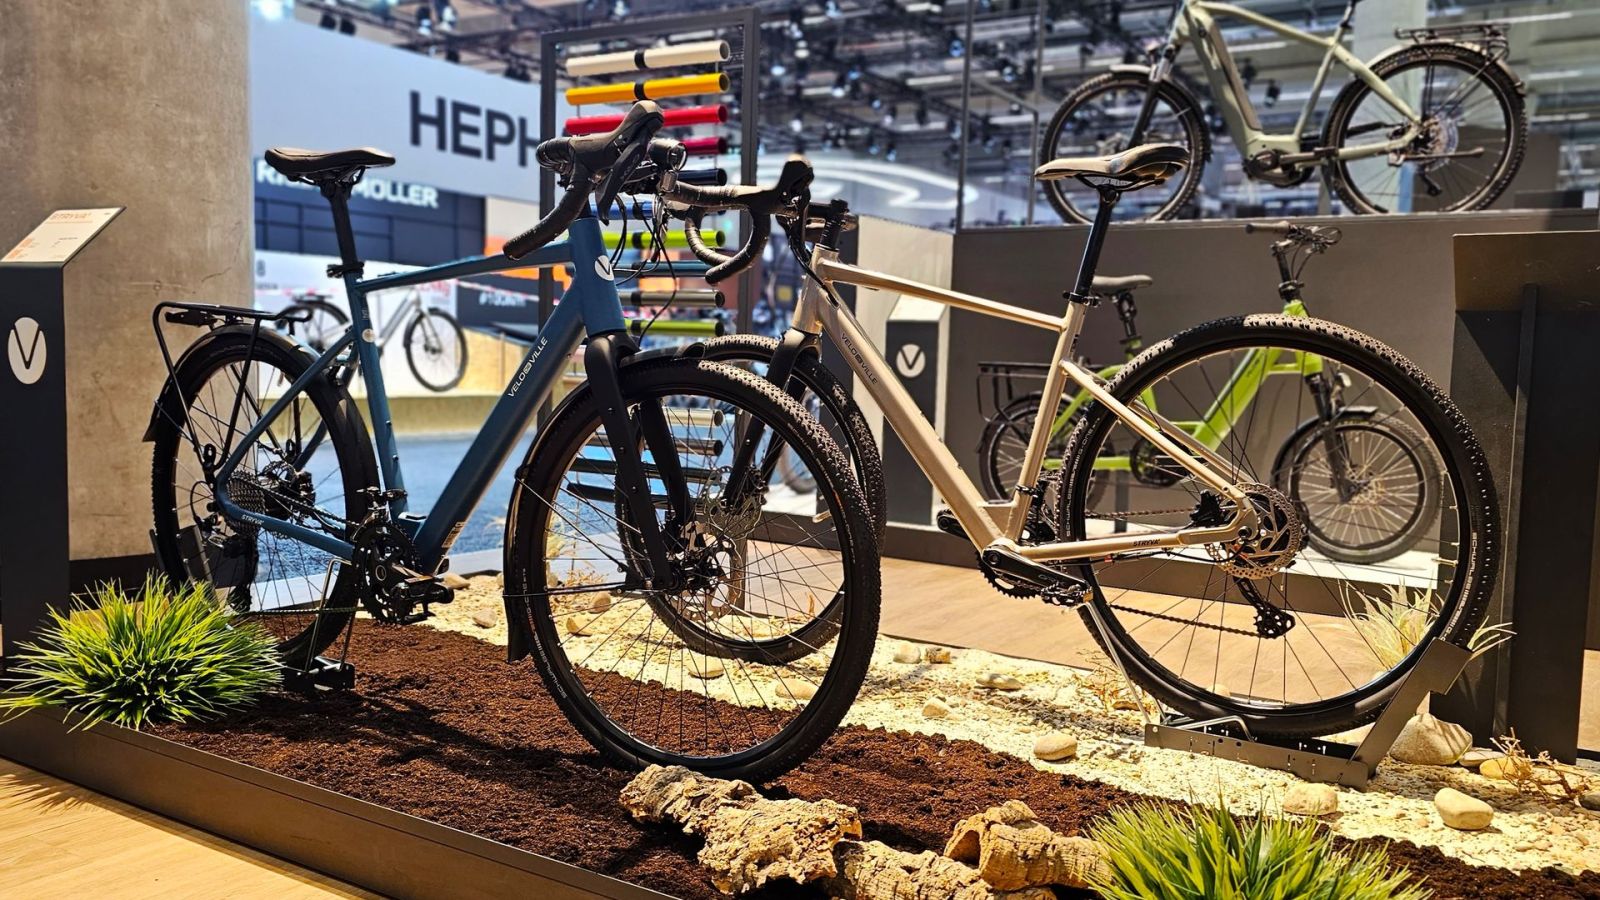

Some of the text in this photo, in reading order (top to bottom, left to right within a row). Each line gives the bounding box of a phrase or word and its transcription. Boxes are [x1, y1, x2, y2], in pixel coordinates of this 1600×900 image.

[508, 336, 548, 397] VELO VILLE
[841, 333, 877, 384] VELO VILLE
